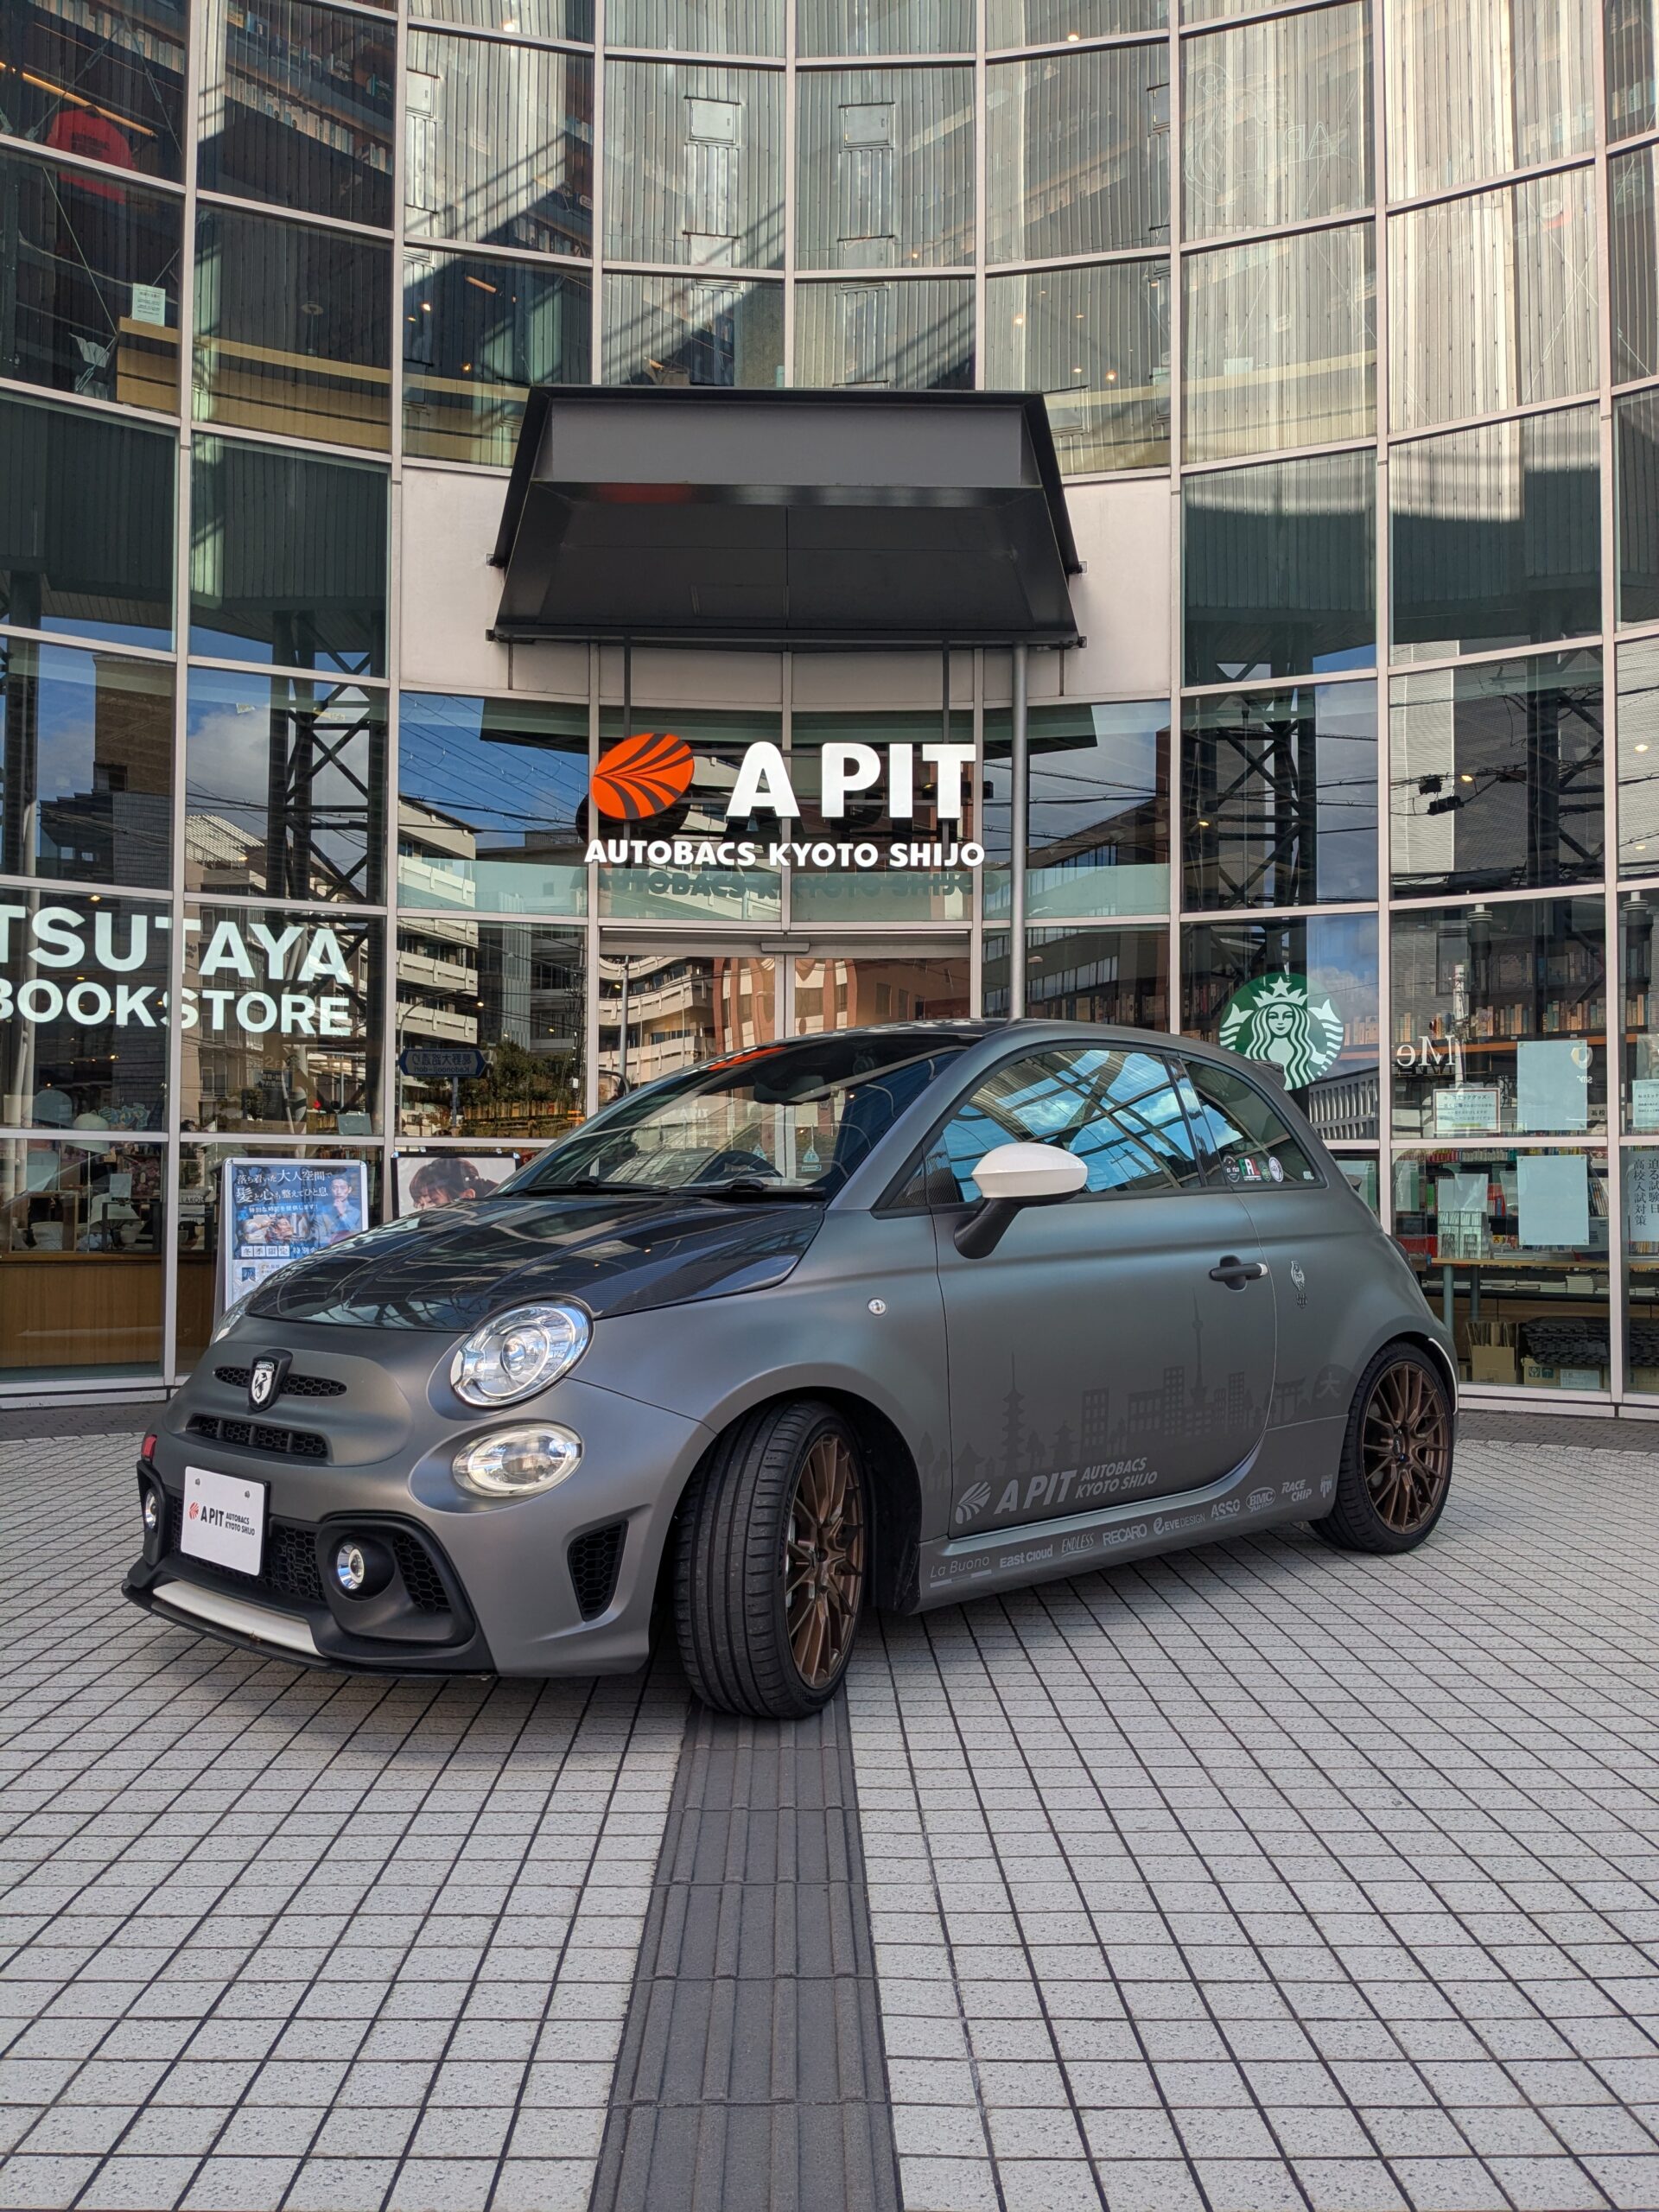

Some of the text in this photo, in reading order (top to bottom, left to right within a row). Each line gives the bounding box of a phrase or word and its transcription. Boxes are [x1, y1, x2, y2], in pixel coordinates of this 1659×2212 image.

[726, 741, 976, 819] A PIT
[584, 839, 986, 868] AUTOBACS KYOTO SHIJO
[237, 1169, 333, 1185] 落ち着いた大人空間で
[236, 1186, 328, 1204] 髪と心も整えてひと息
[1633, 1159, 1647, 1226] 高校入試対策
[1081, 1457, 1147, 1482] AUTOBACS
[994, 1470, 1077, 1515] A PIT
[1075, 1471, 1158, 1499] KYOTO SHIJO
[1281, 1479, 1306, 1494] RACE
[1291, 1489, 1313, 1502] CHIP
[1211, 1498, 1241, 1518] ASSO
[1249, 1491, 1274, 1507] BMC
[200, 1505, 225, 1527] A PIT
[226, 1512, 250, 1525] AUTOBACS
[1180, 1513, 1205, 1529] DESIGN
[225, 1521, 256, 1536] KYOTO SHIJO
[1102, 1522, 1147, 1547] RECARO
[1061, 1533, 1094, 1554] ENDLESS
[930, 1555, 990, 1579] La Buono
